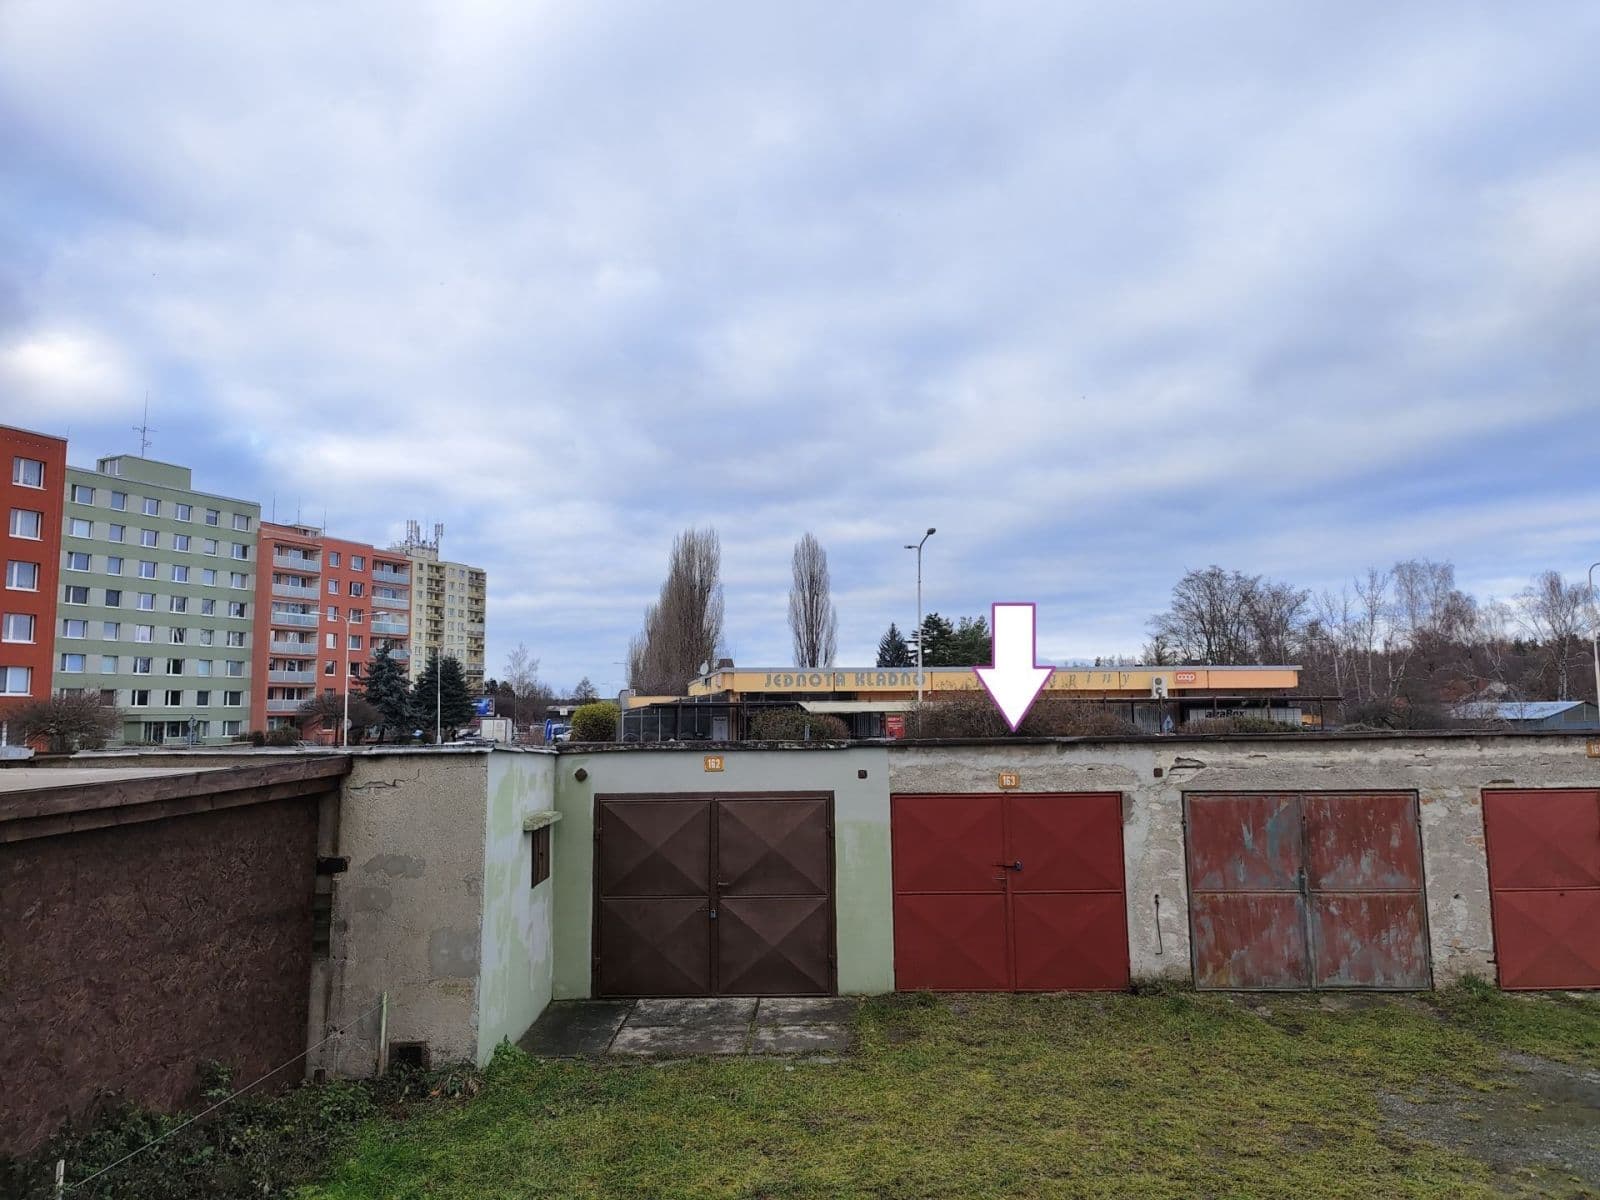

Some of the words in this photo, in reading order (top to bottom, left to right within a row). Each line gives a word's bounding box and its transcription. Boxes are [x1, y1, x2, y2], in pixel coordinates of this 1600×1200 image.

[765, 672, 846, 687] JEDNOTA
[855, 671, 926, 687] KLADNO
[1177, 673, 1195, 682] coop
[708, 758, 721, 769] 162
[1003, 775, 1016, 786] 163
